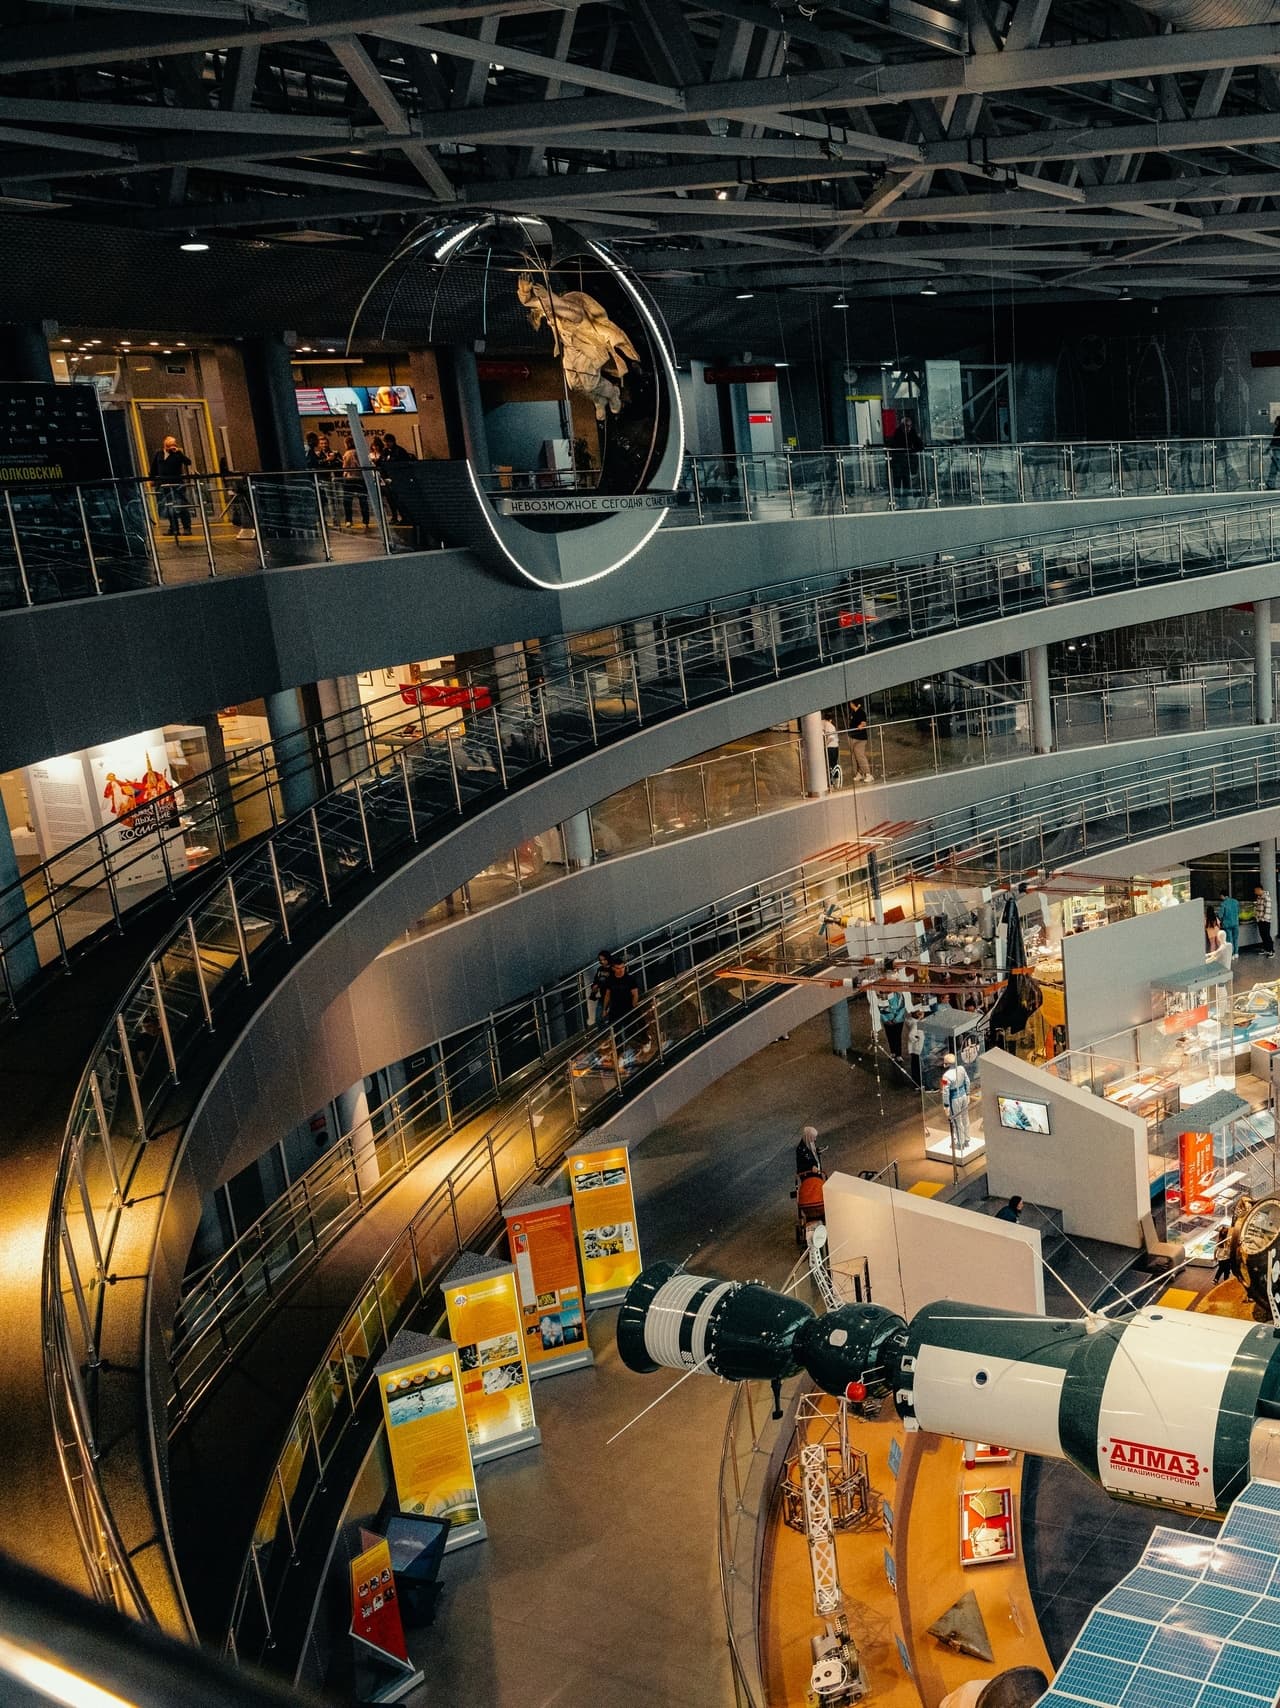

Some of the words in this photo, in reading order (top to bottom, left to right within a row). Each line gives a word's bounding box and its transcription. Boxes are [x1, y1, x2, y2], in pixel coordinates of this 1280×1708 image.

[511, 499, 598, 512] НЕВОЗМОЖНОЕ
[601, 497, 643, 509] СЕГОДНЯ
[134, 811, 172, 826] ДЫХИЕ
[1110, 1443, 1200, 1477] АЛМАЗ
[1110, 1463, 1126, 1472] НПО
[1127, 1467, 1200, 1487] МАШИНОСТРОЕНИЯ
